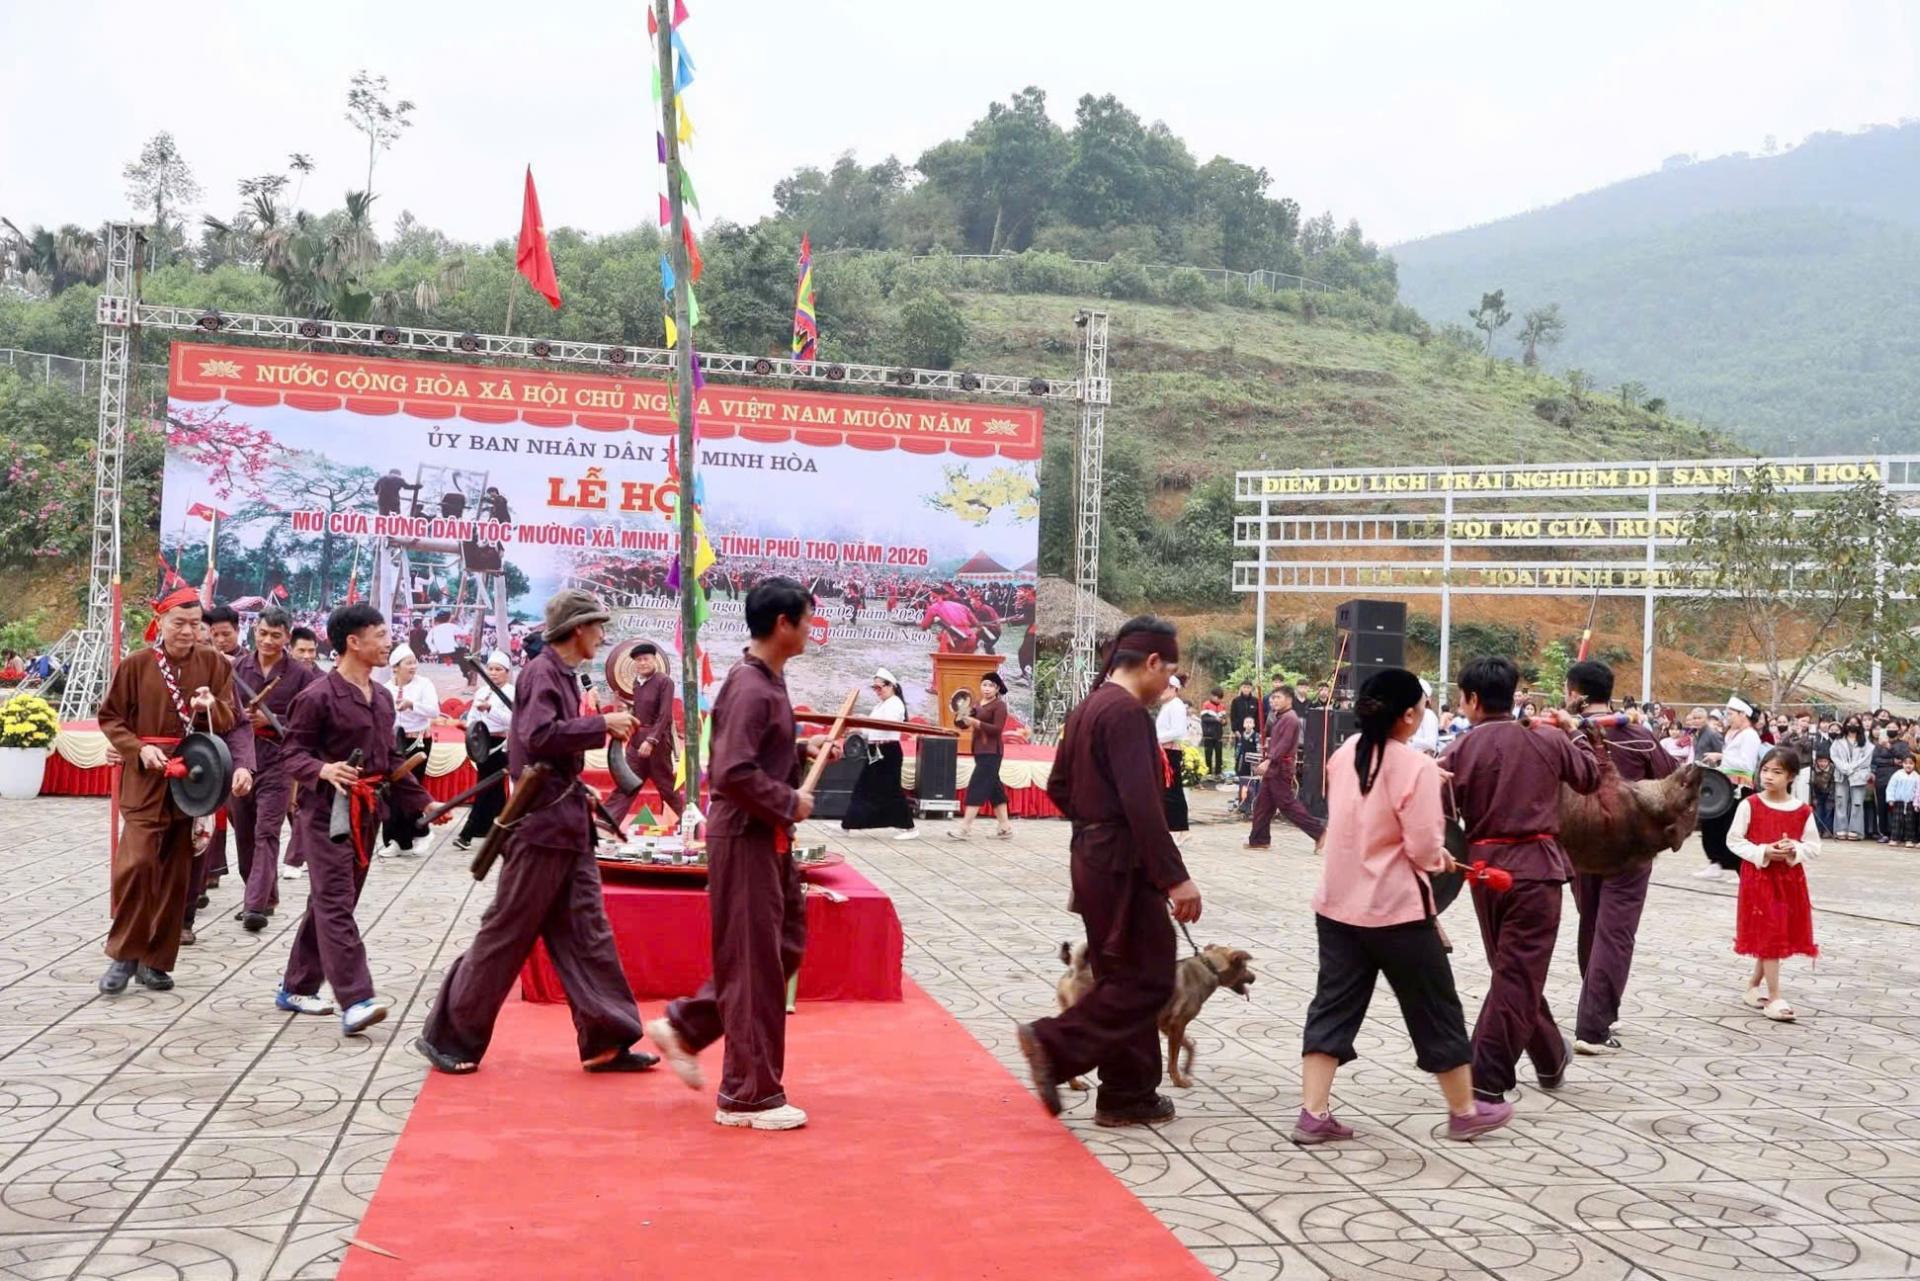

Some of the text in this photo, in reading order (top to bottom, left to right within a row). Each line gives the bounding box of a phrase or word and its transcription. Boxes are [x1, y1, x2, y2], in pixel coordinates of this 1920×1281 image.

[256, 363, 972, 434] NƯỚC CỘNG HÒA XÃ HỘI CHỦ NGA VIỆT NAM MUÔN NĂM
[427, 425, 462, 448] ỦY
[469, 435, 520, 453] BAN
[526, 437, 596, 457] NHÂN
[604, 441, 654, 462] DÂN
[702, 451, 764, 469] MINH
[770, 453, 818, 472] HÒA
[547, 467, 702, 520] LỄ HỘ
[1328, 476, 1362, 492] DU
[1369, 475, 1426, 496] LỊCH
[1512, 467, 1618, 491] NGHIỆM
[1627, 467, 1658, 486] DI
[292, 506, 325, 531] MỞ
[330, 507, 368, 534] CỬA
[374, 512, 427, 537] RỪNG
[432, 516, 472, 540] DÂN
[478, 518, 512, 547] TỘC
[518, 521, 586, 546] MƯỜNG
[591, 525, 616, 548] XÃ
[621, 531, 669, 551] MINH
[720, 531, 760, 556] TỈNH
[765, 537, 800, 558] PHÚ
[806, 541, 837, 564] THỌ
[843, 541, 882, 563] NĂM
[887, 547, 928, 566] 2026
[629, 594, 669, 609] Minh
[837, 606, 855, 618] 02
[893, 608, 924, 621] 2026
